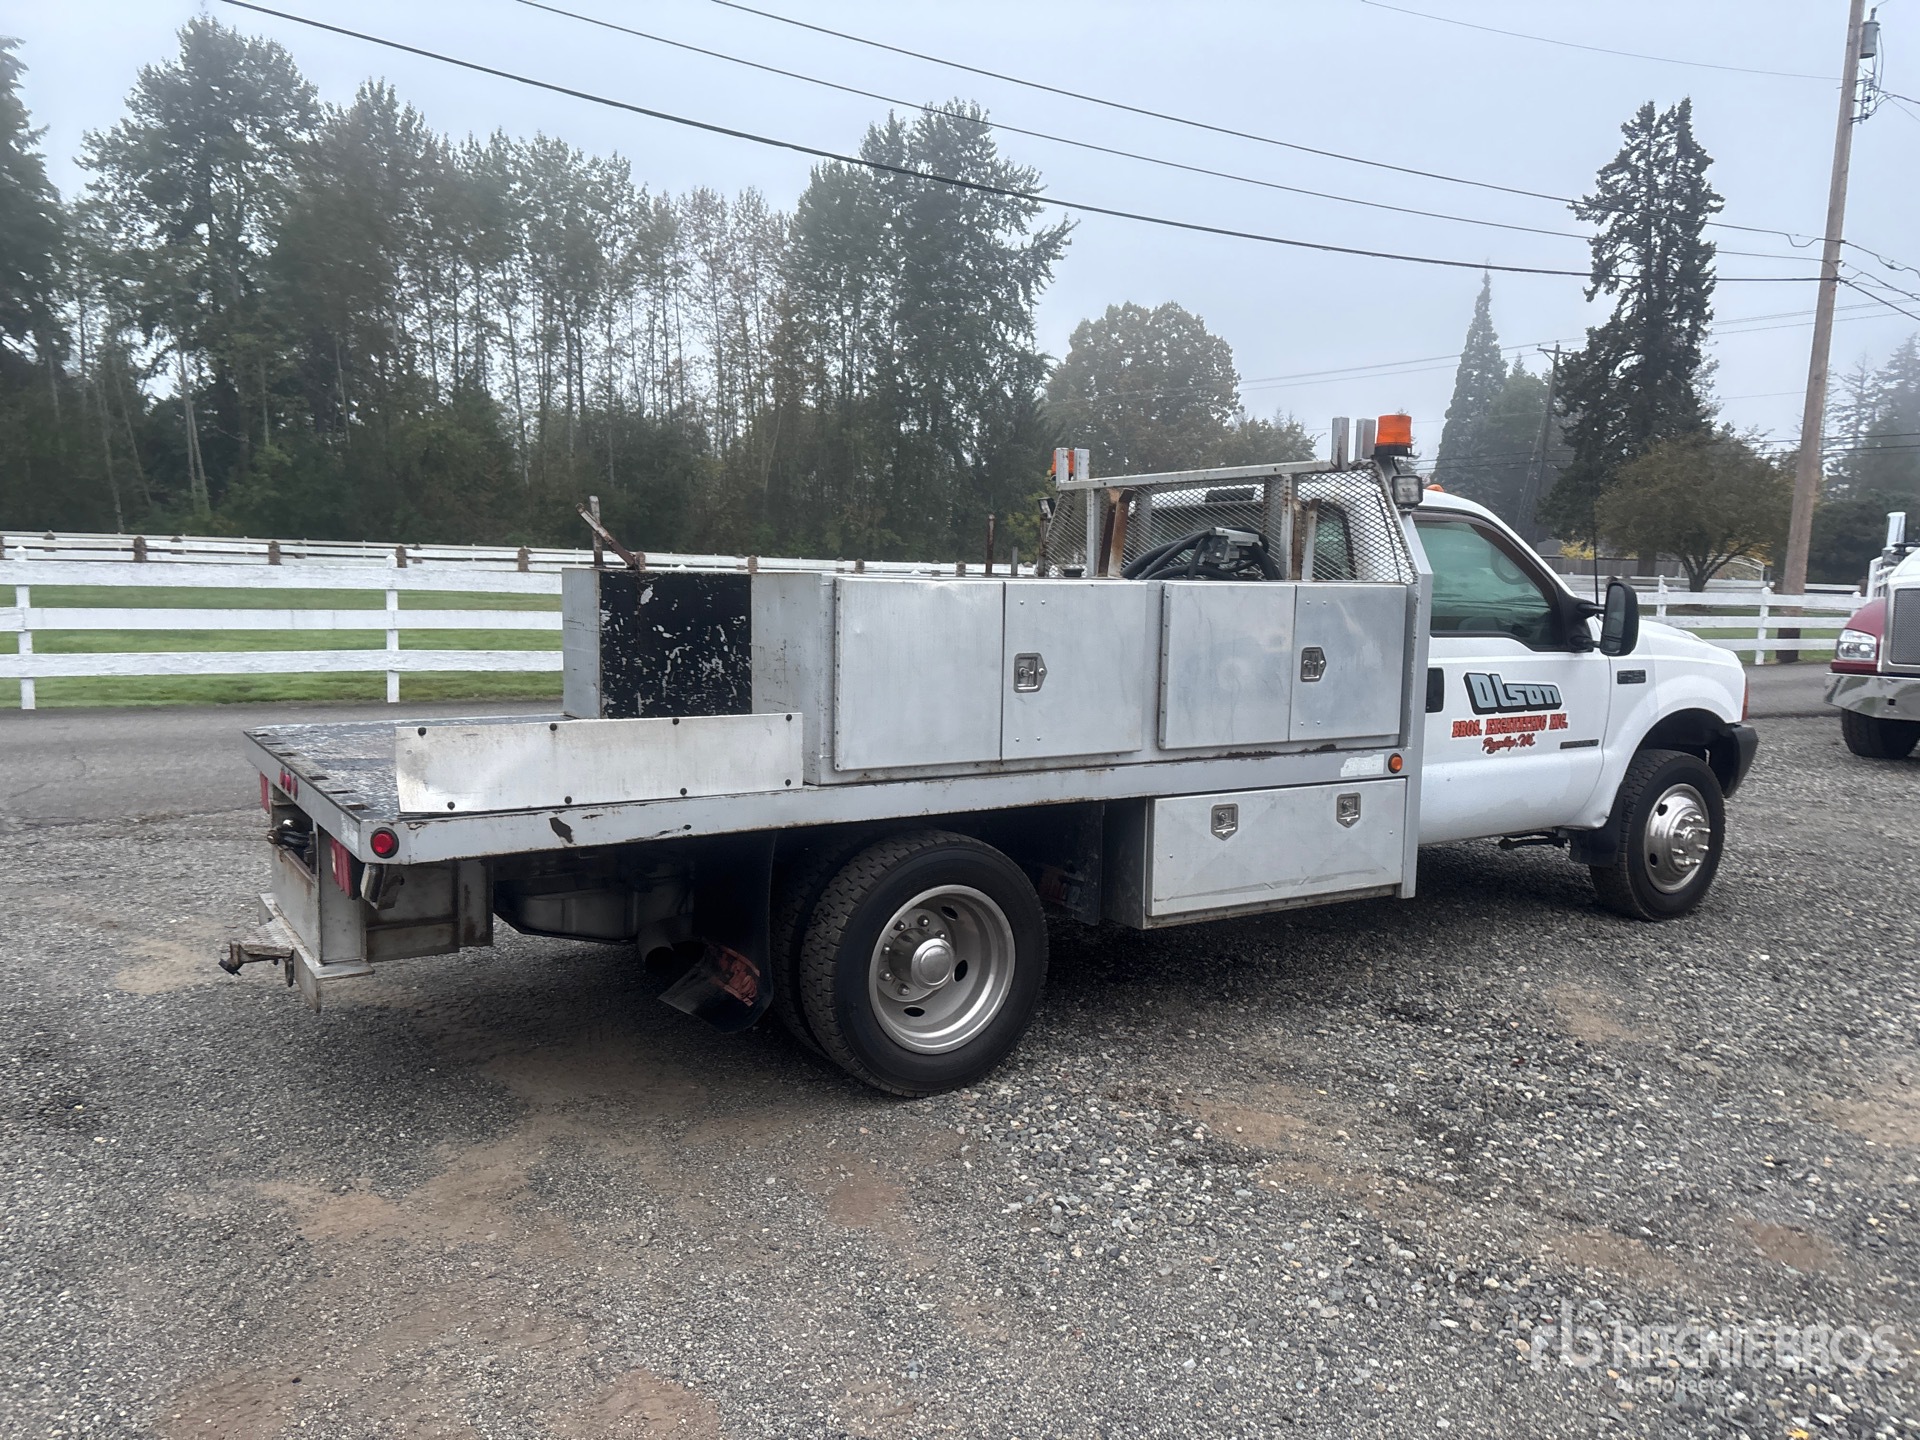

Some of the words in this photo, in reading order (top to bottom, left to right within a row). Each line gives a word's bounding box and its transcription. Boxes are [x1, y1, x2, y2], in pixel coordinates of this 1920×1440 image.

[1463, 672, 1562, 715] Olson
[1452, 720, 1482, 738] BROS.
[1485, 714, 1547, 735] EXCAVATING
[1549, 713, 1568, 730] INC.
